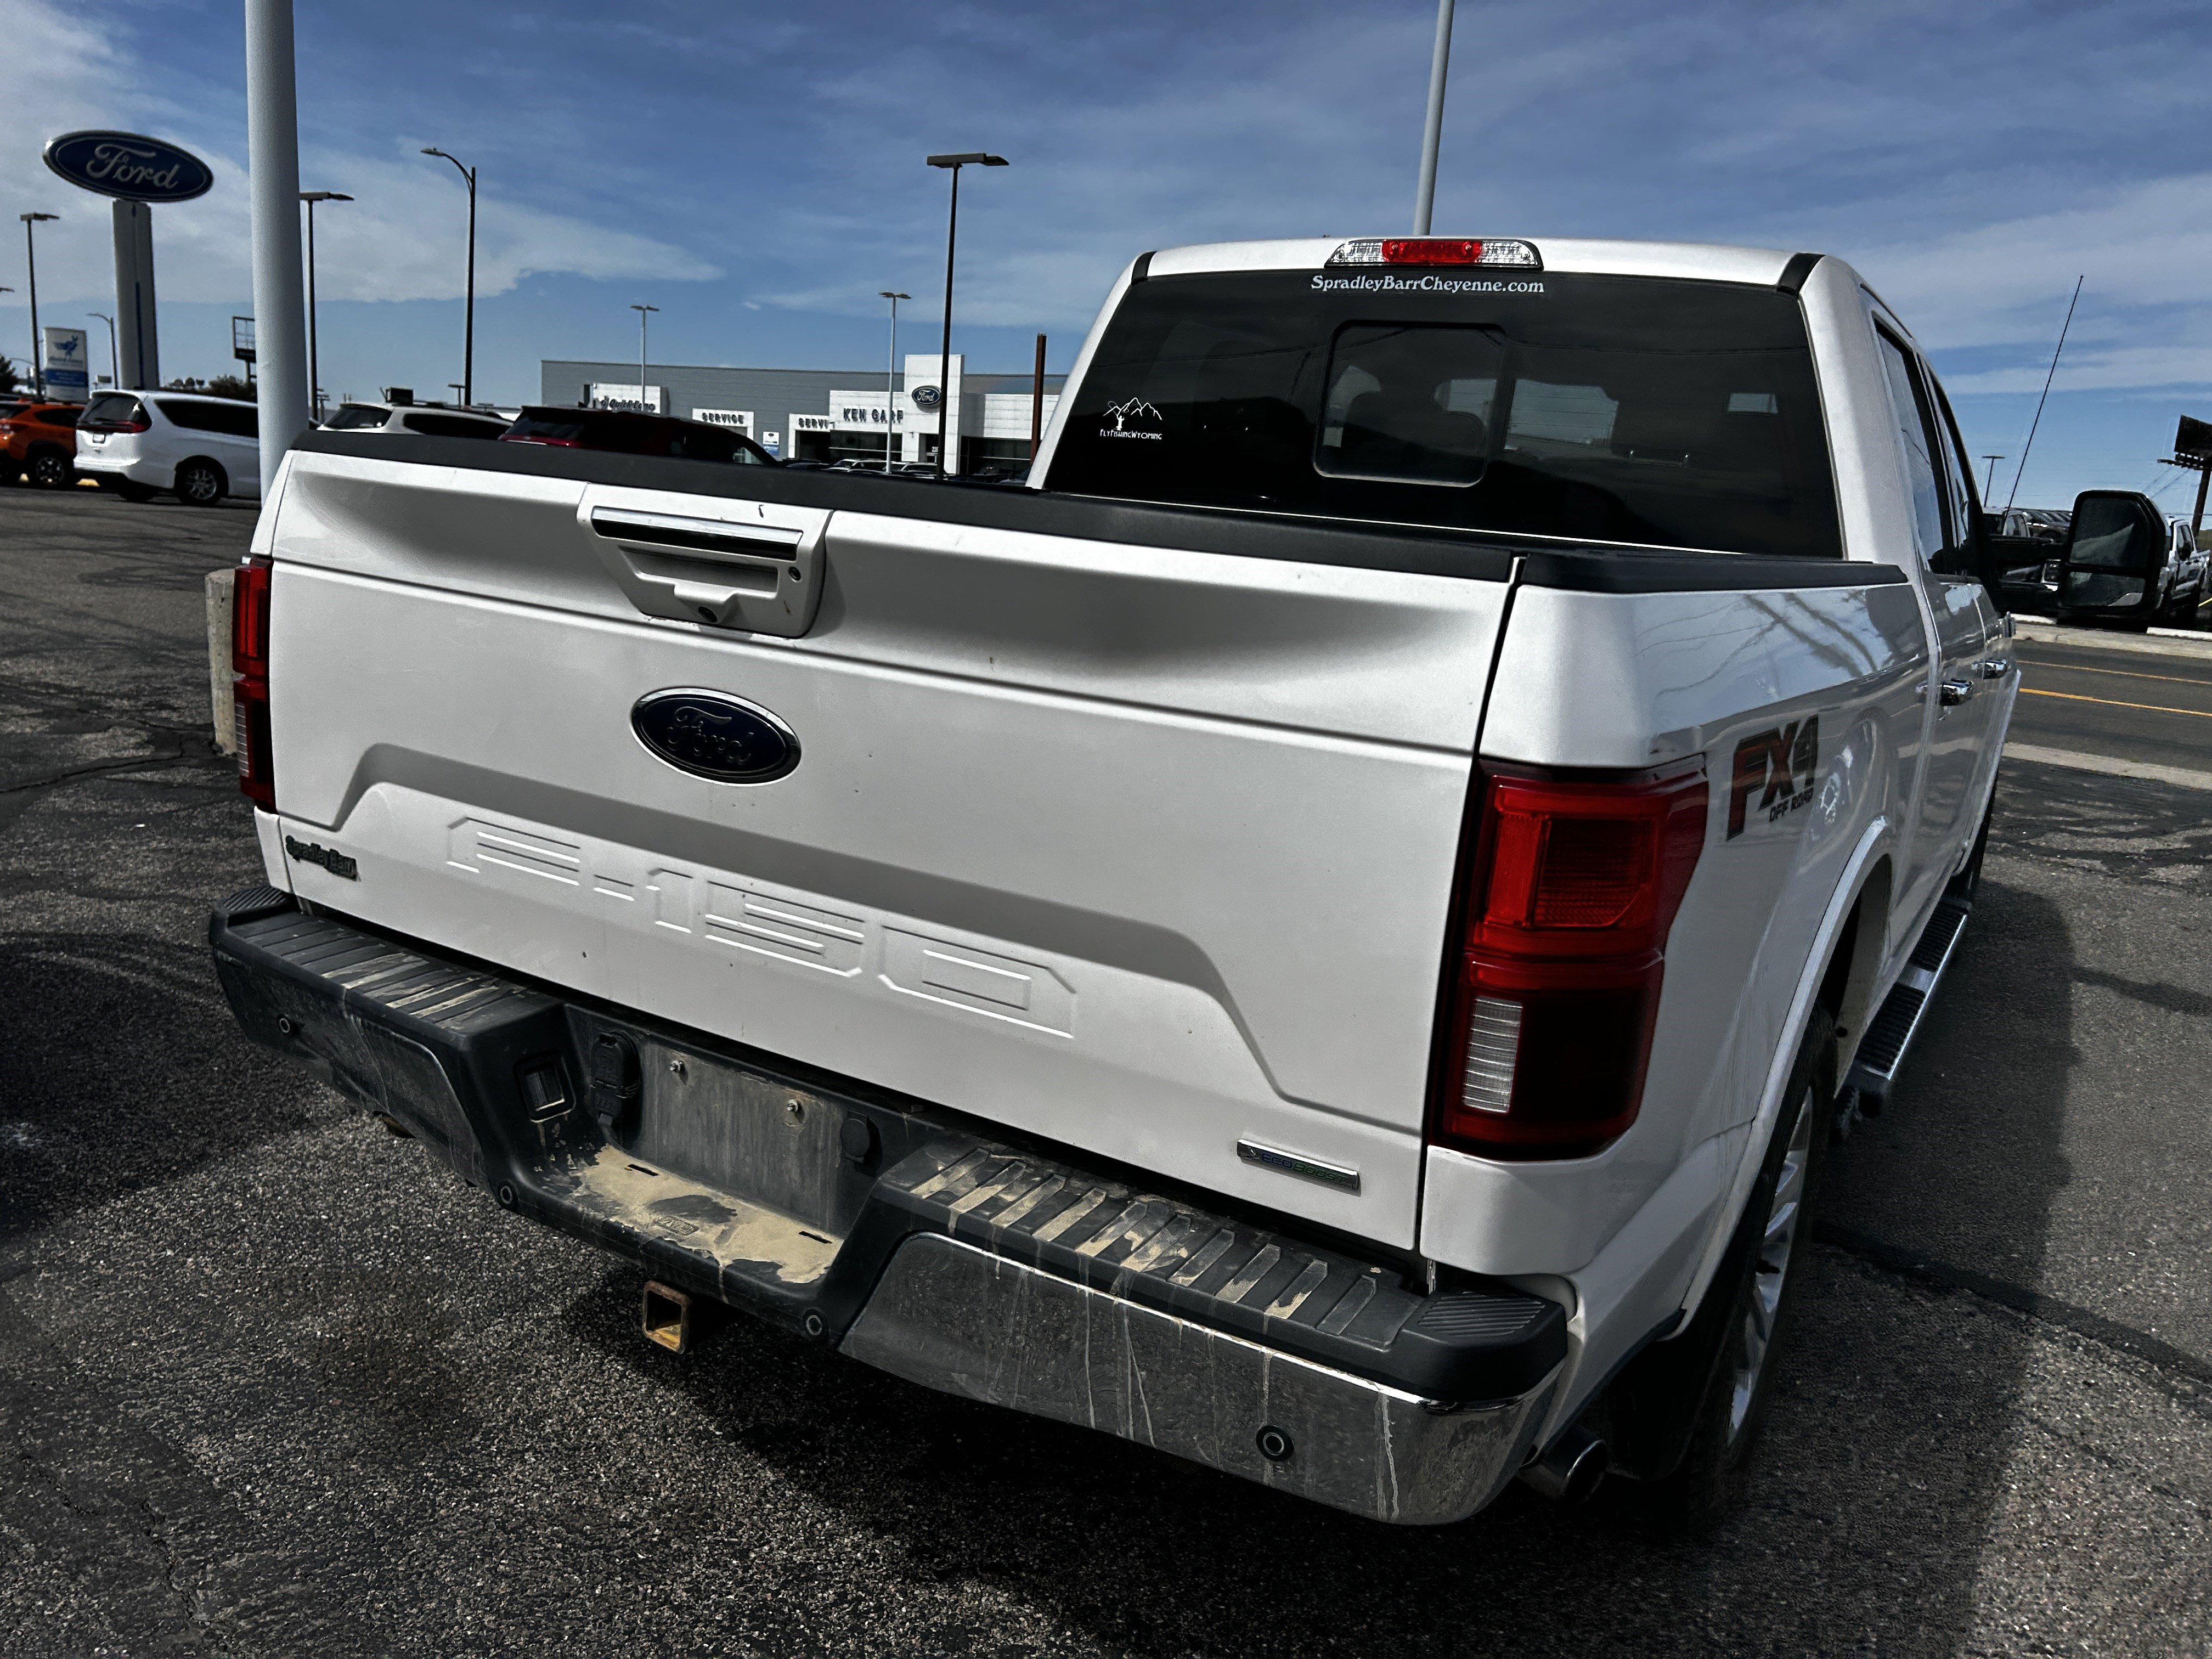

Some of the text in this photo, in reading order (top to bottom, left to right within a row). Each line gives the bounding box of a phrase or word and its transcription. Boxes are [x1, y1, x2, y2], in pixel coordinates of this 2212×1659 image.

[86, 143, 180, 189] Ford
[1311, 275, 1545, 293] SpradleyBarrCheyenne.com
[917, 390, 935, 402] Ford
[702, 412, 744, 425] SERVICE
[843, 408, 867, 422] KEN
[667, 706, 755, 765] Ford
[1726, 713, 1819, 842] FX4
[447, 816, 1077, 1040] F-150
